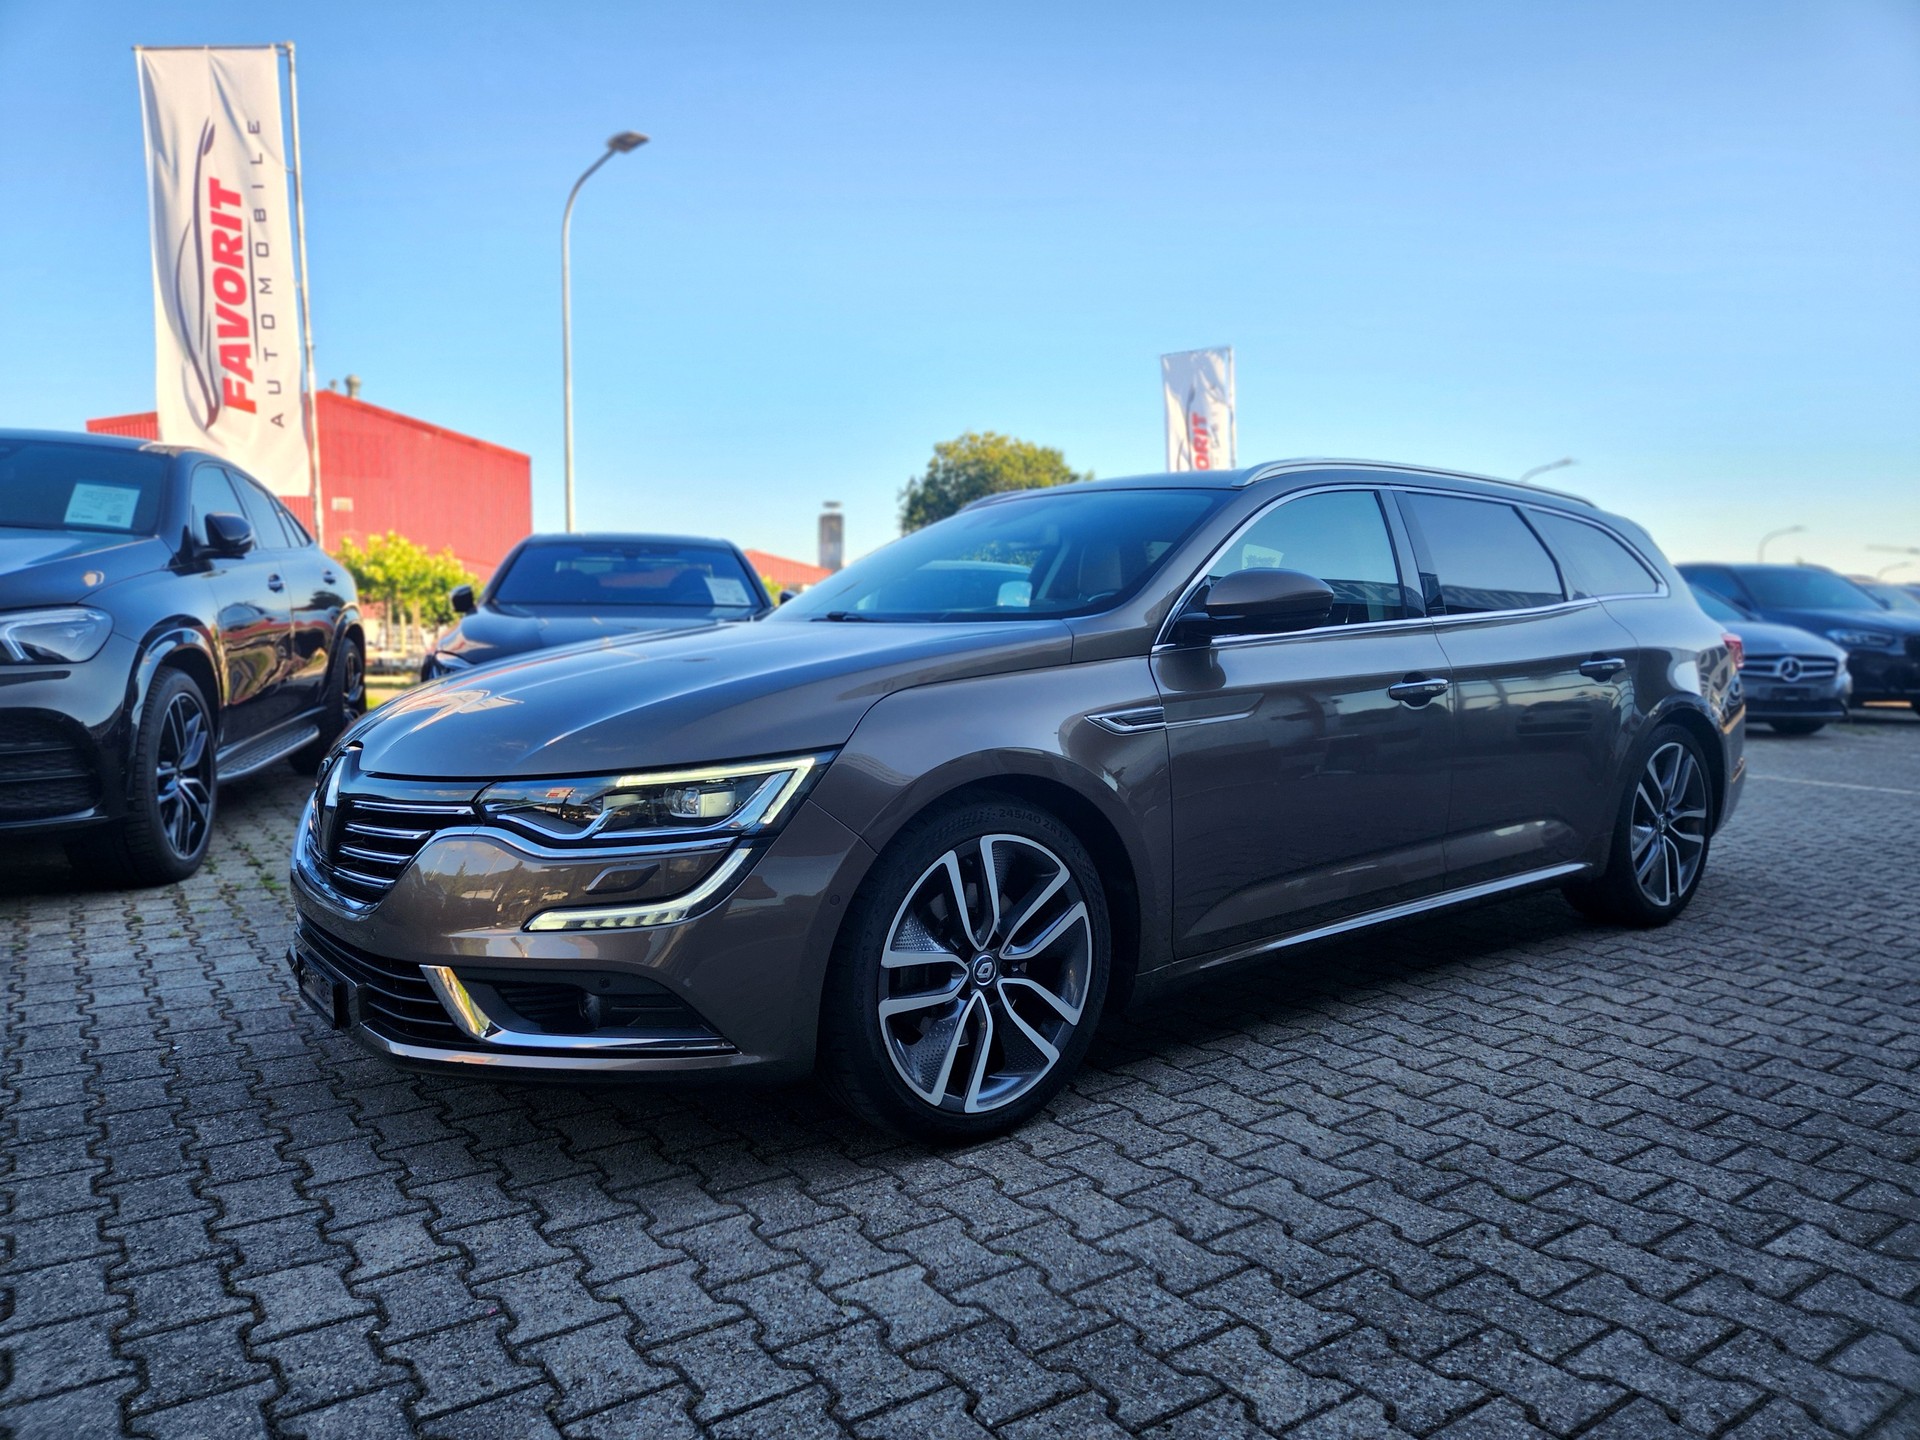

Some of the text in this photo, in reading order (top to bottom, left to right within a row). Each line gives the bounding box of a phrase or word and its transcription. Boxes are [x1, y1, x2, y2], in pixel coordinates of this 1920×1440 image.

[208, 176, 257, 414] FAVORIT
[247, 119, 285, 428] AUTOMOBILE
[999, 808, 1041, 824] 245/40
